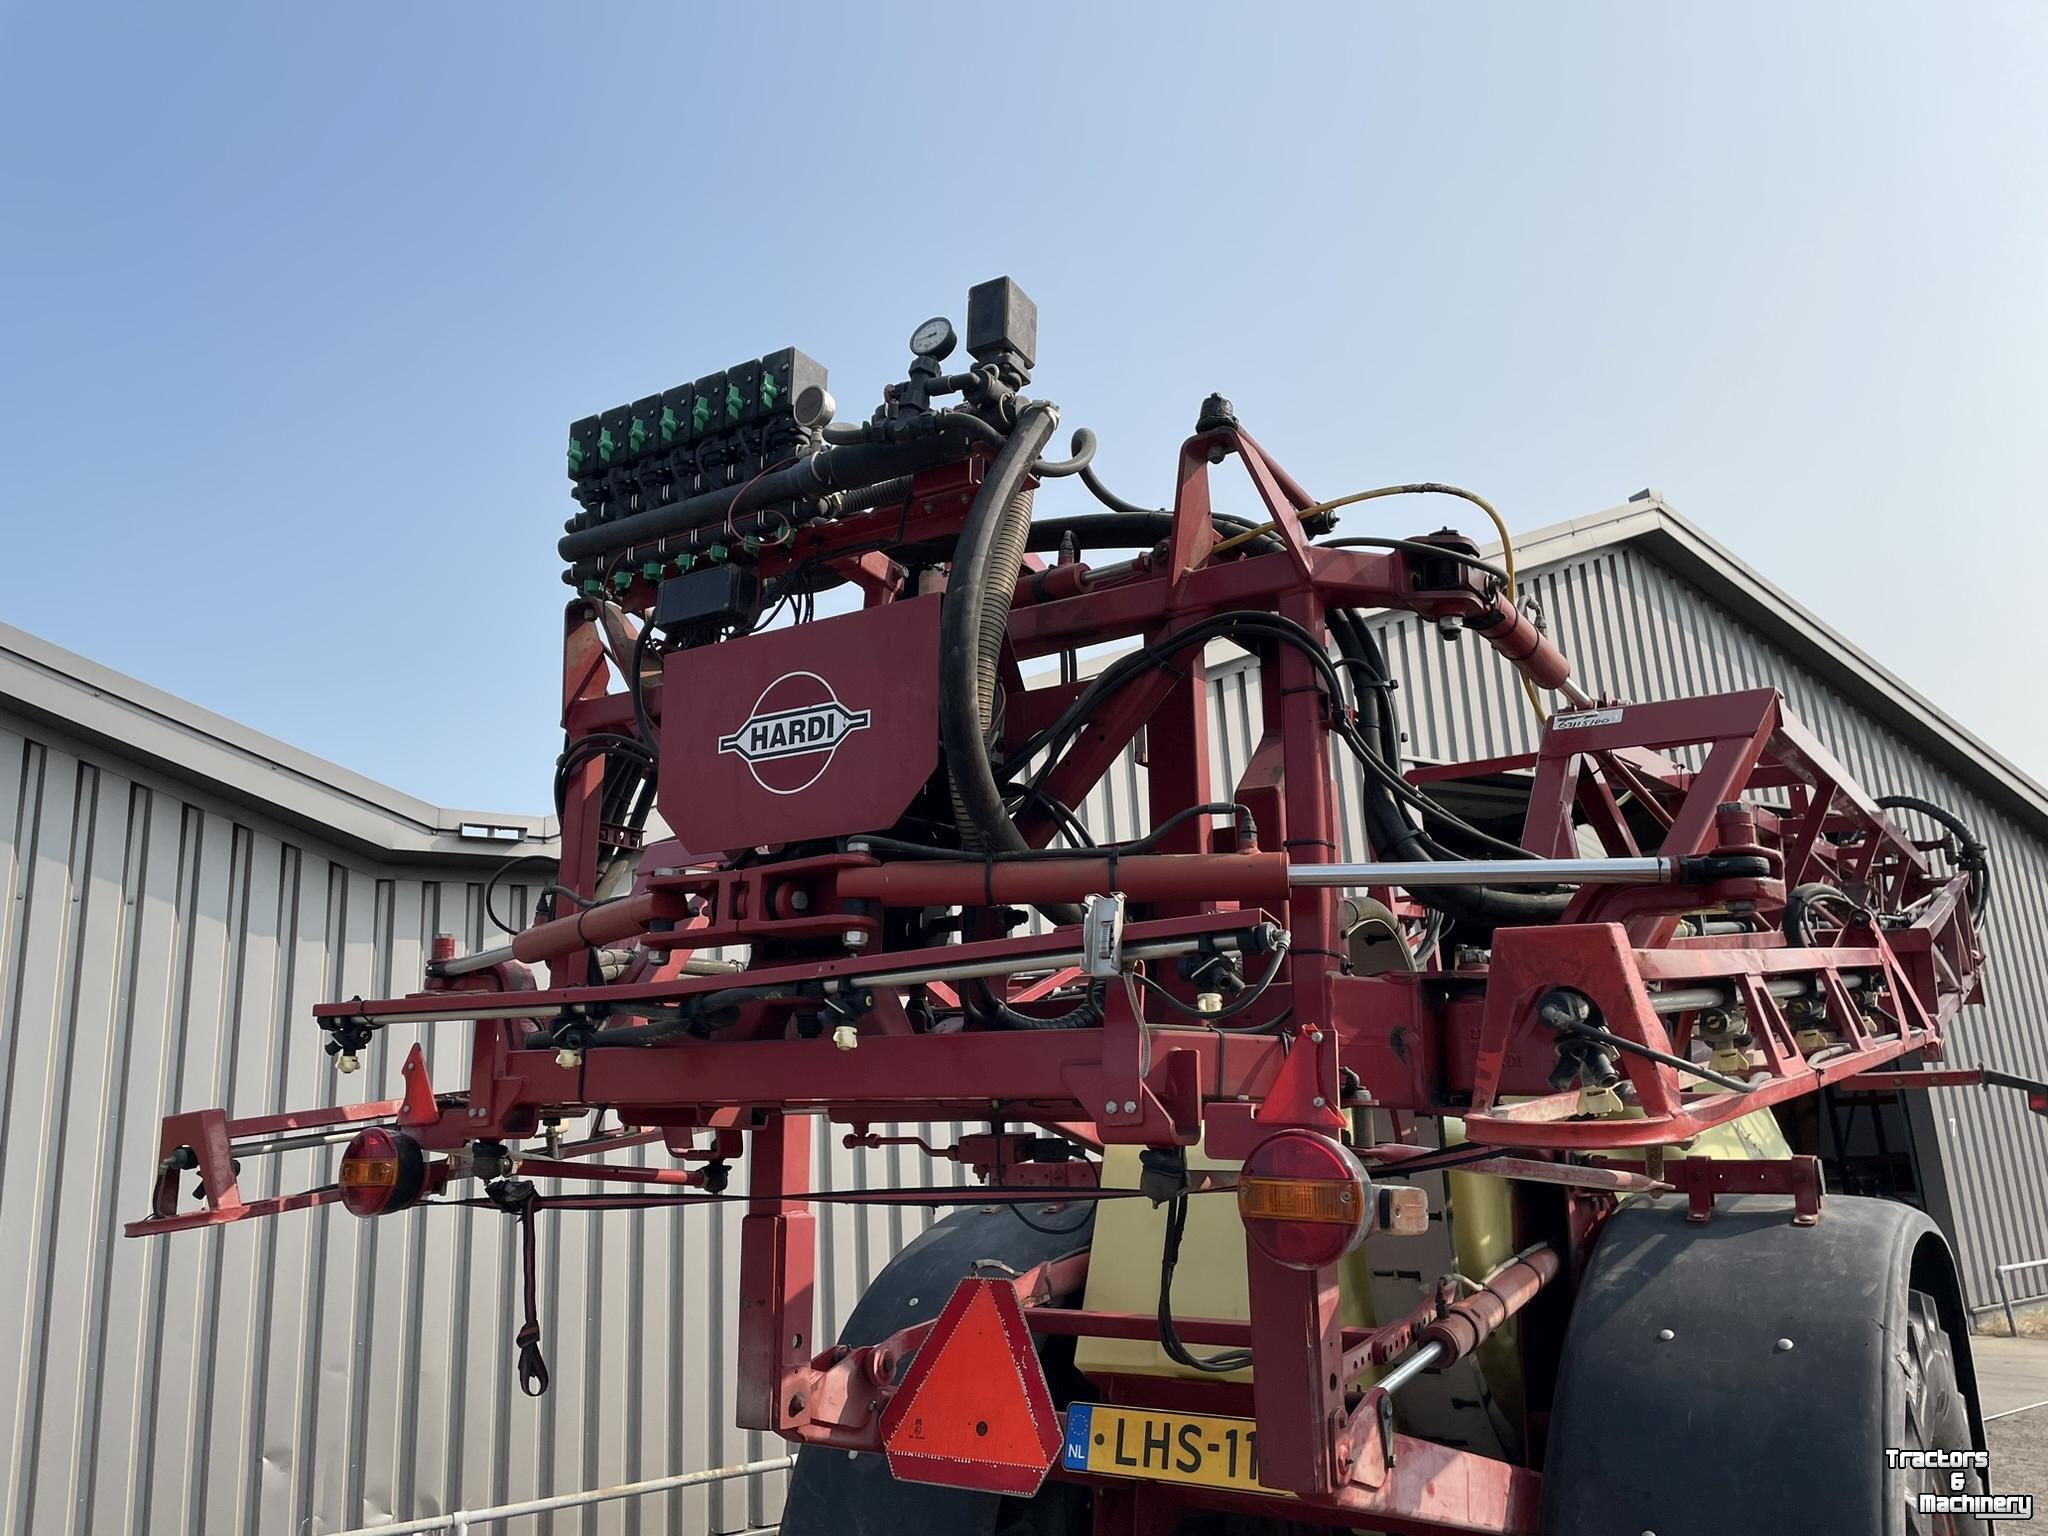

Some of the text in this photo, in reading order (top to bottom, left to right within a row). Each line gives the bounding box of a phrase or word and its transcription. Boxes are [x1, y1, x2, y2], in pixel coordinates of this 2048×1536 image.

[750, 713, 835, 752] HARDI
[1948, 1117, 1956, 1137] 7
[1068, 1444, 1085, 1459] NL
